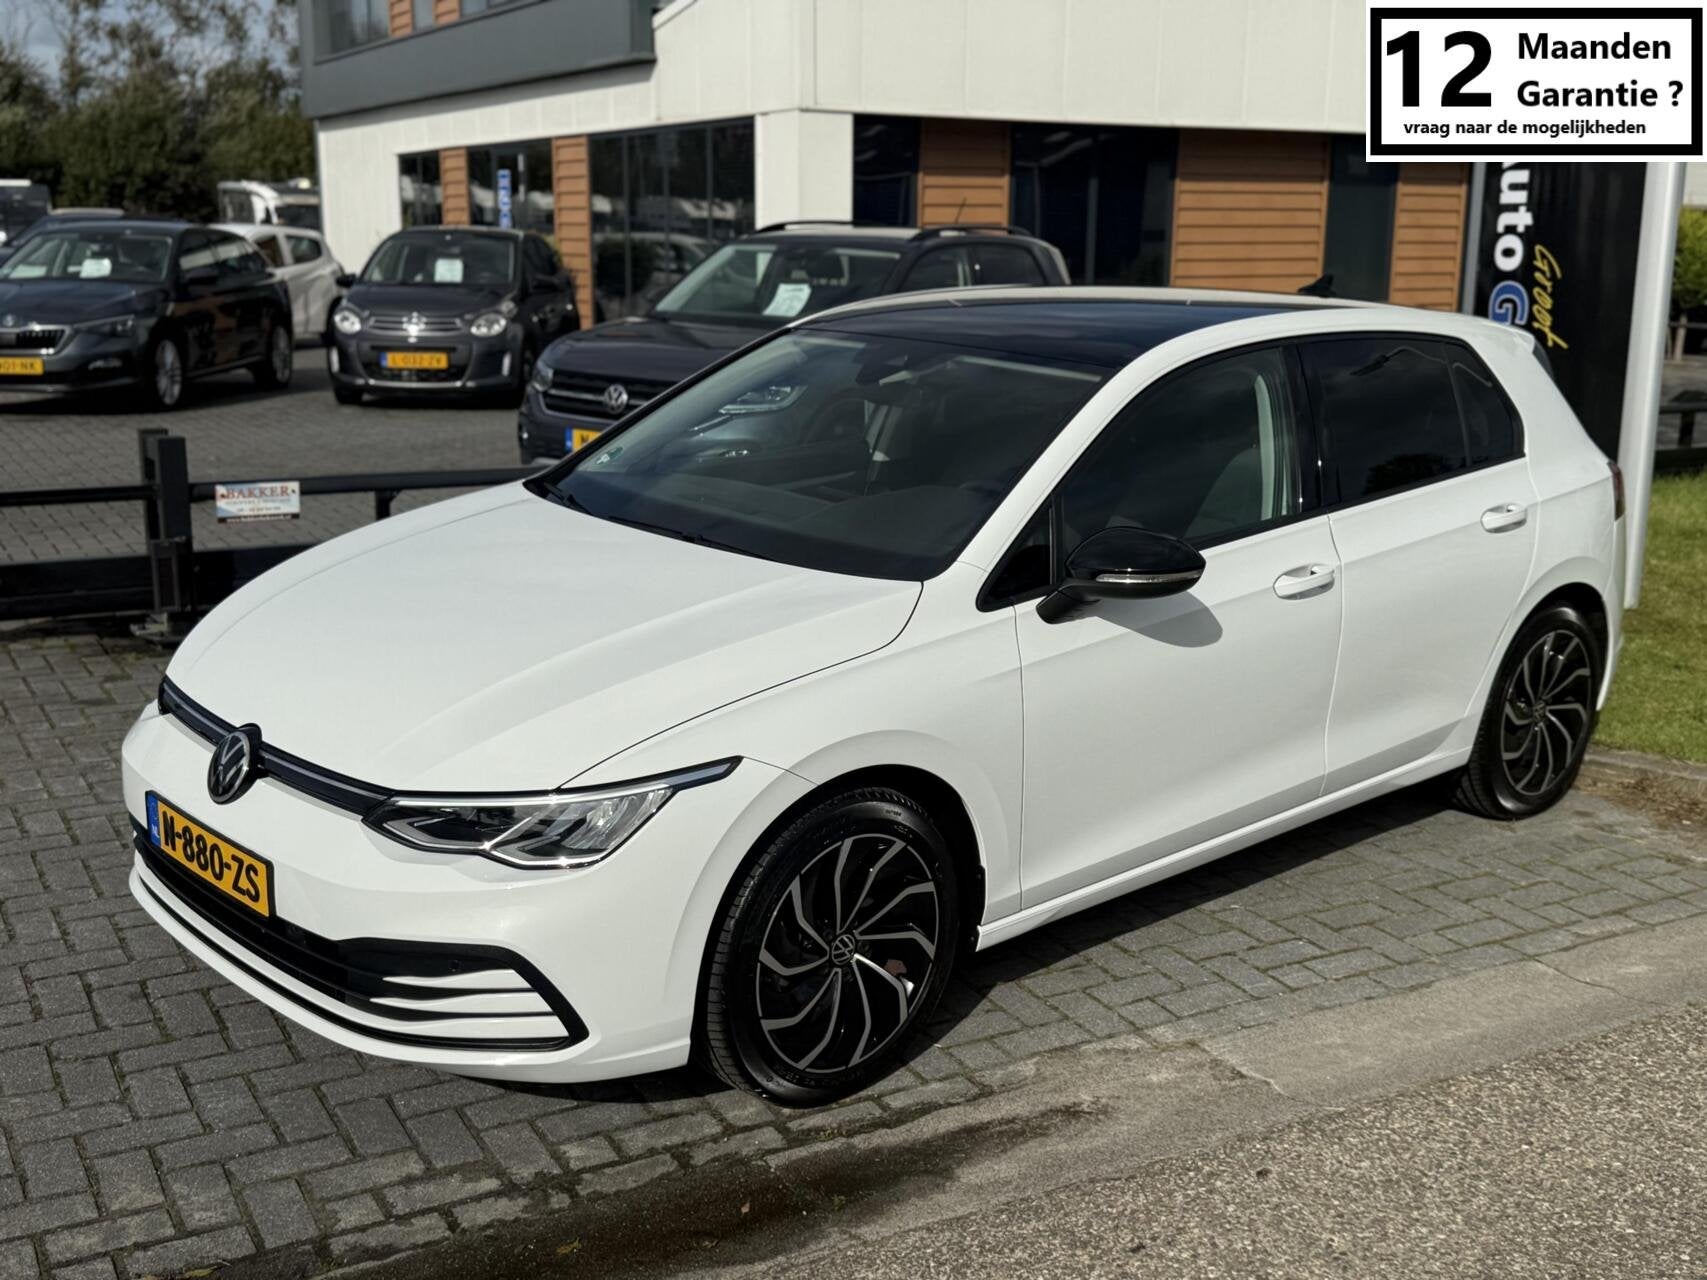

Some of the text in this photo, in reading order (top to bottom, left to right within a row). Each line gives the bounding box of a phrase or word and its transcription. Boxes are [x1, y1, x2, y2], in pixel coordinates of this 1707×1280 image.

[1494, 162, 1533, 272] uto
[1533, 244, 1569, 349] Groot
[226, 485, 289, 499] BAKKER
[162, 810, 260, 903] N-880-ZS
